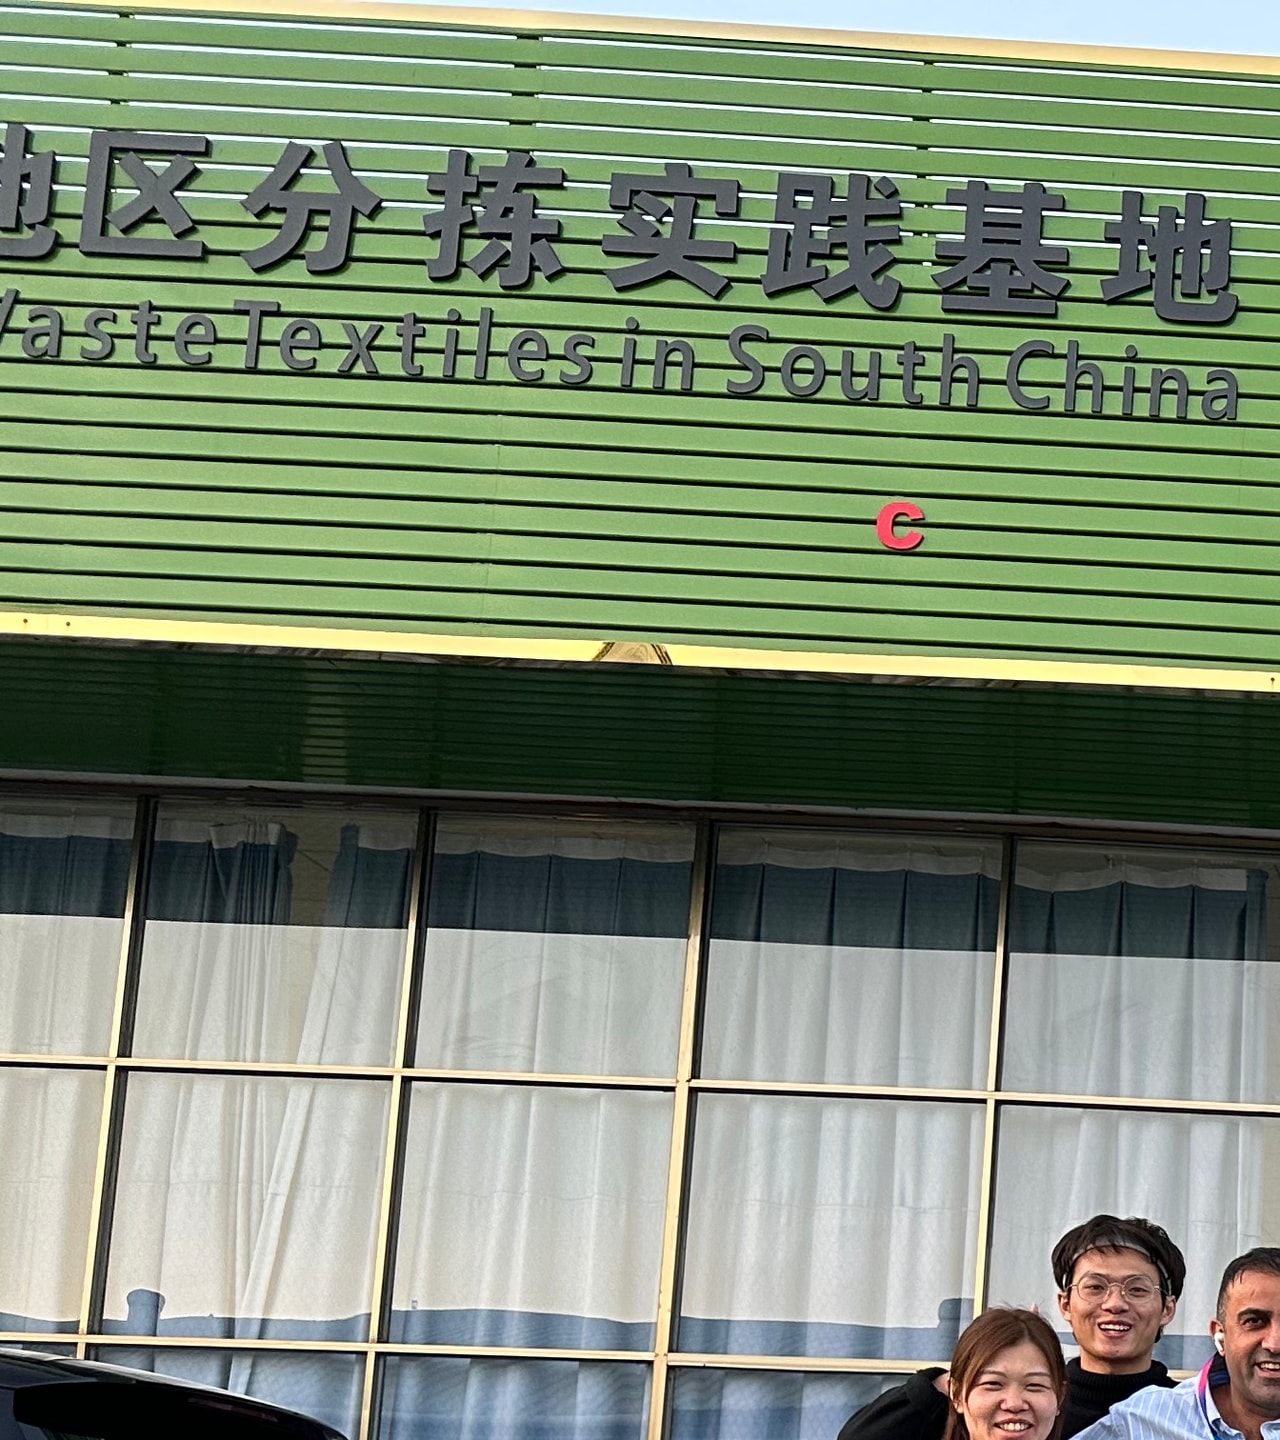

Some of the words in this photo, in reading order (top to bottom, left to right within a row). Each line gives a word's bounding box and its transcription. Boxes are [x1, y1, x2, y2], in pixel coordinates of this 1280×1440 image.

[0, 288, 217, 365] aste
[234, 298, 595, 384] Textiles
[620, 316, 695, 391] in
[726, 324, 979, 407] South
[1006, 339, 1239, 421] China
[876, 501, 925, 551] C
